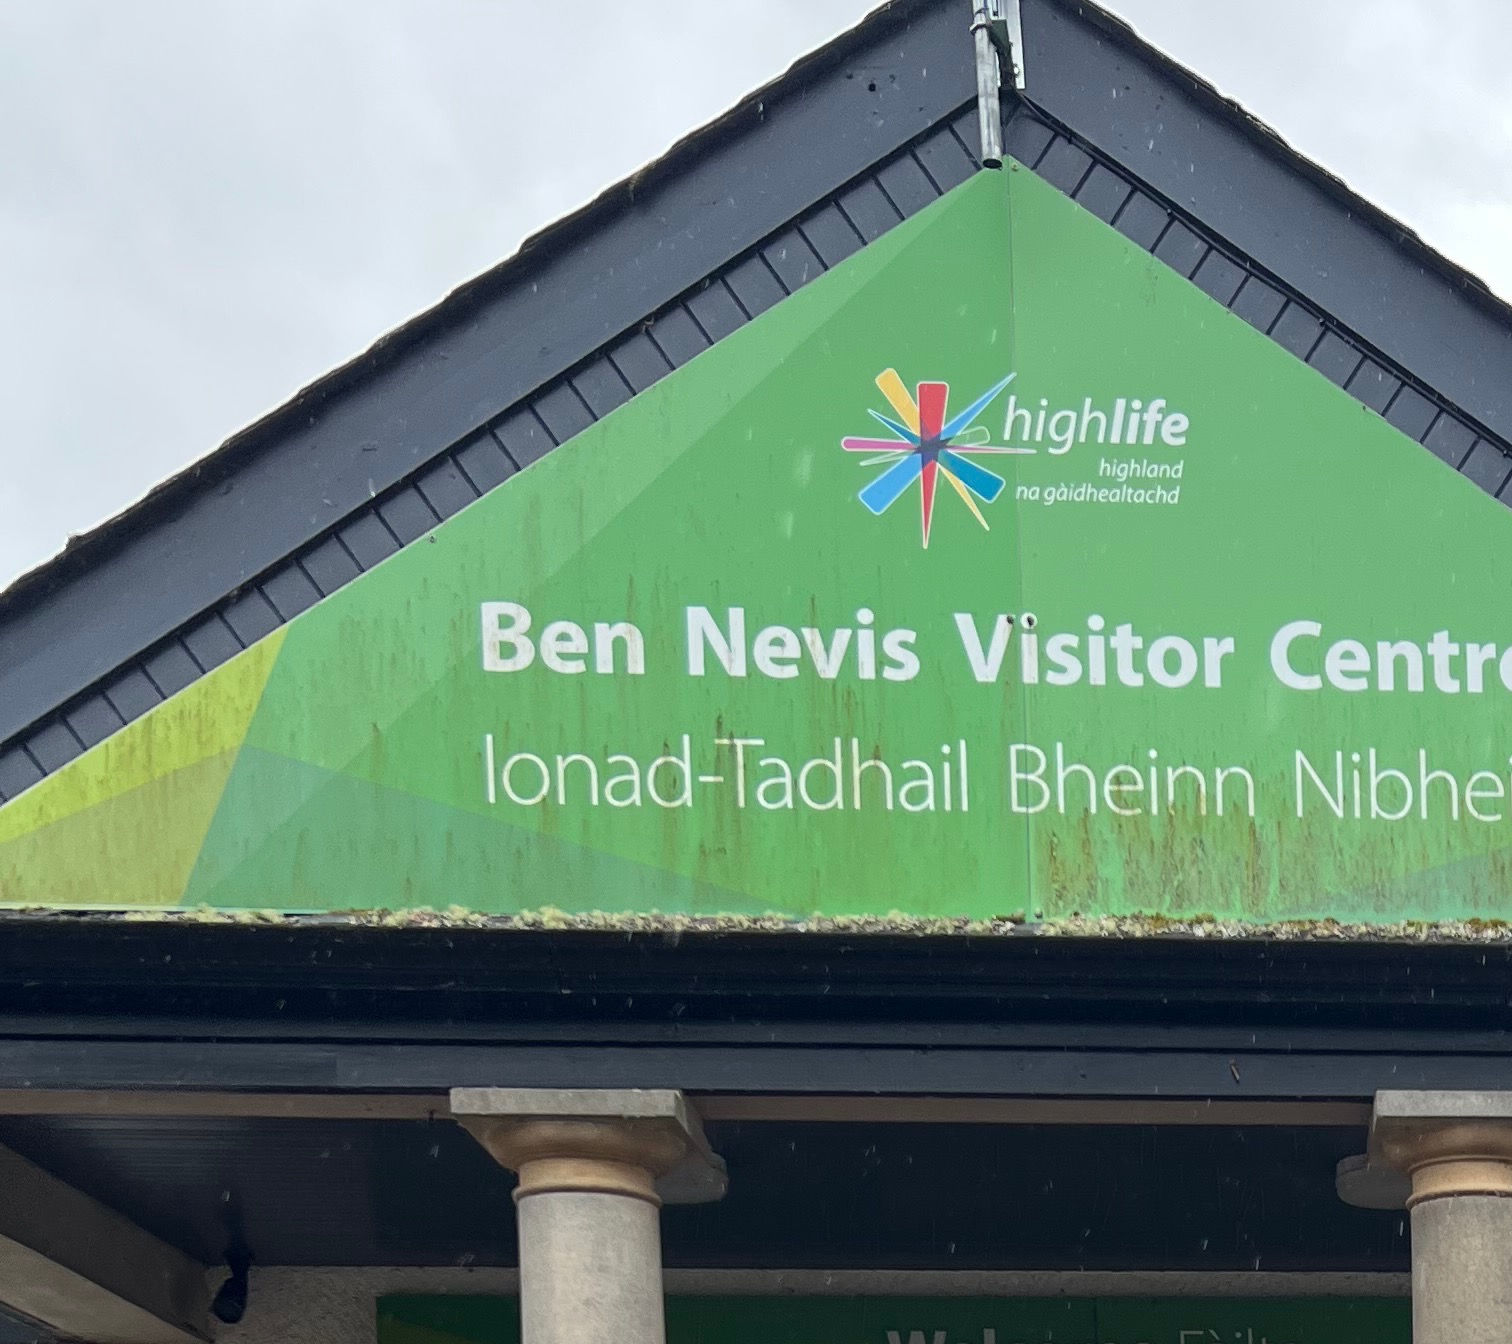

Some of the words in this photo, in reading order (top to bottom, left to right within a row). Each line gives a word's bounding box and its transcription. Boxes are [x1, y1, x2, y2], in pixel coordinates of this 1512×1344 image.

[1016, 483, 1038, 500] na
[1044, 482, 1180, 506] gàidhealtachd
[1099, 457, 1184, 482] highland
[480, 601, 646, 675] Ben
[686, 606, 920, 681] Nevis
[953, 612, 1235, 688] Visitor
[485, 733, 970, 812] Ionad-Tadhail
[1009, 741, 1256, 817] Bheinn
